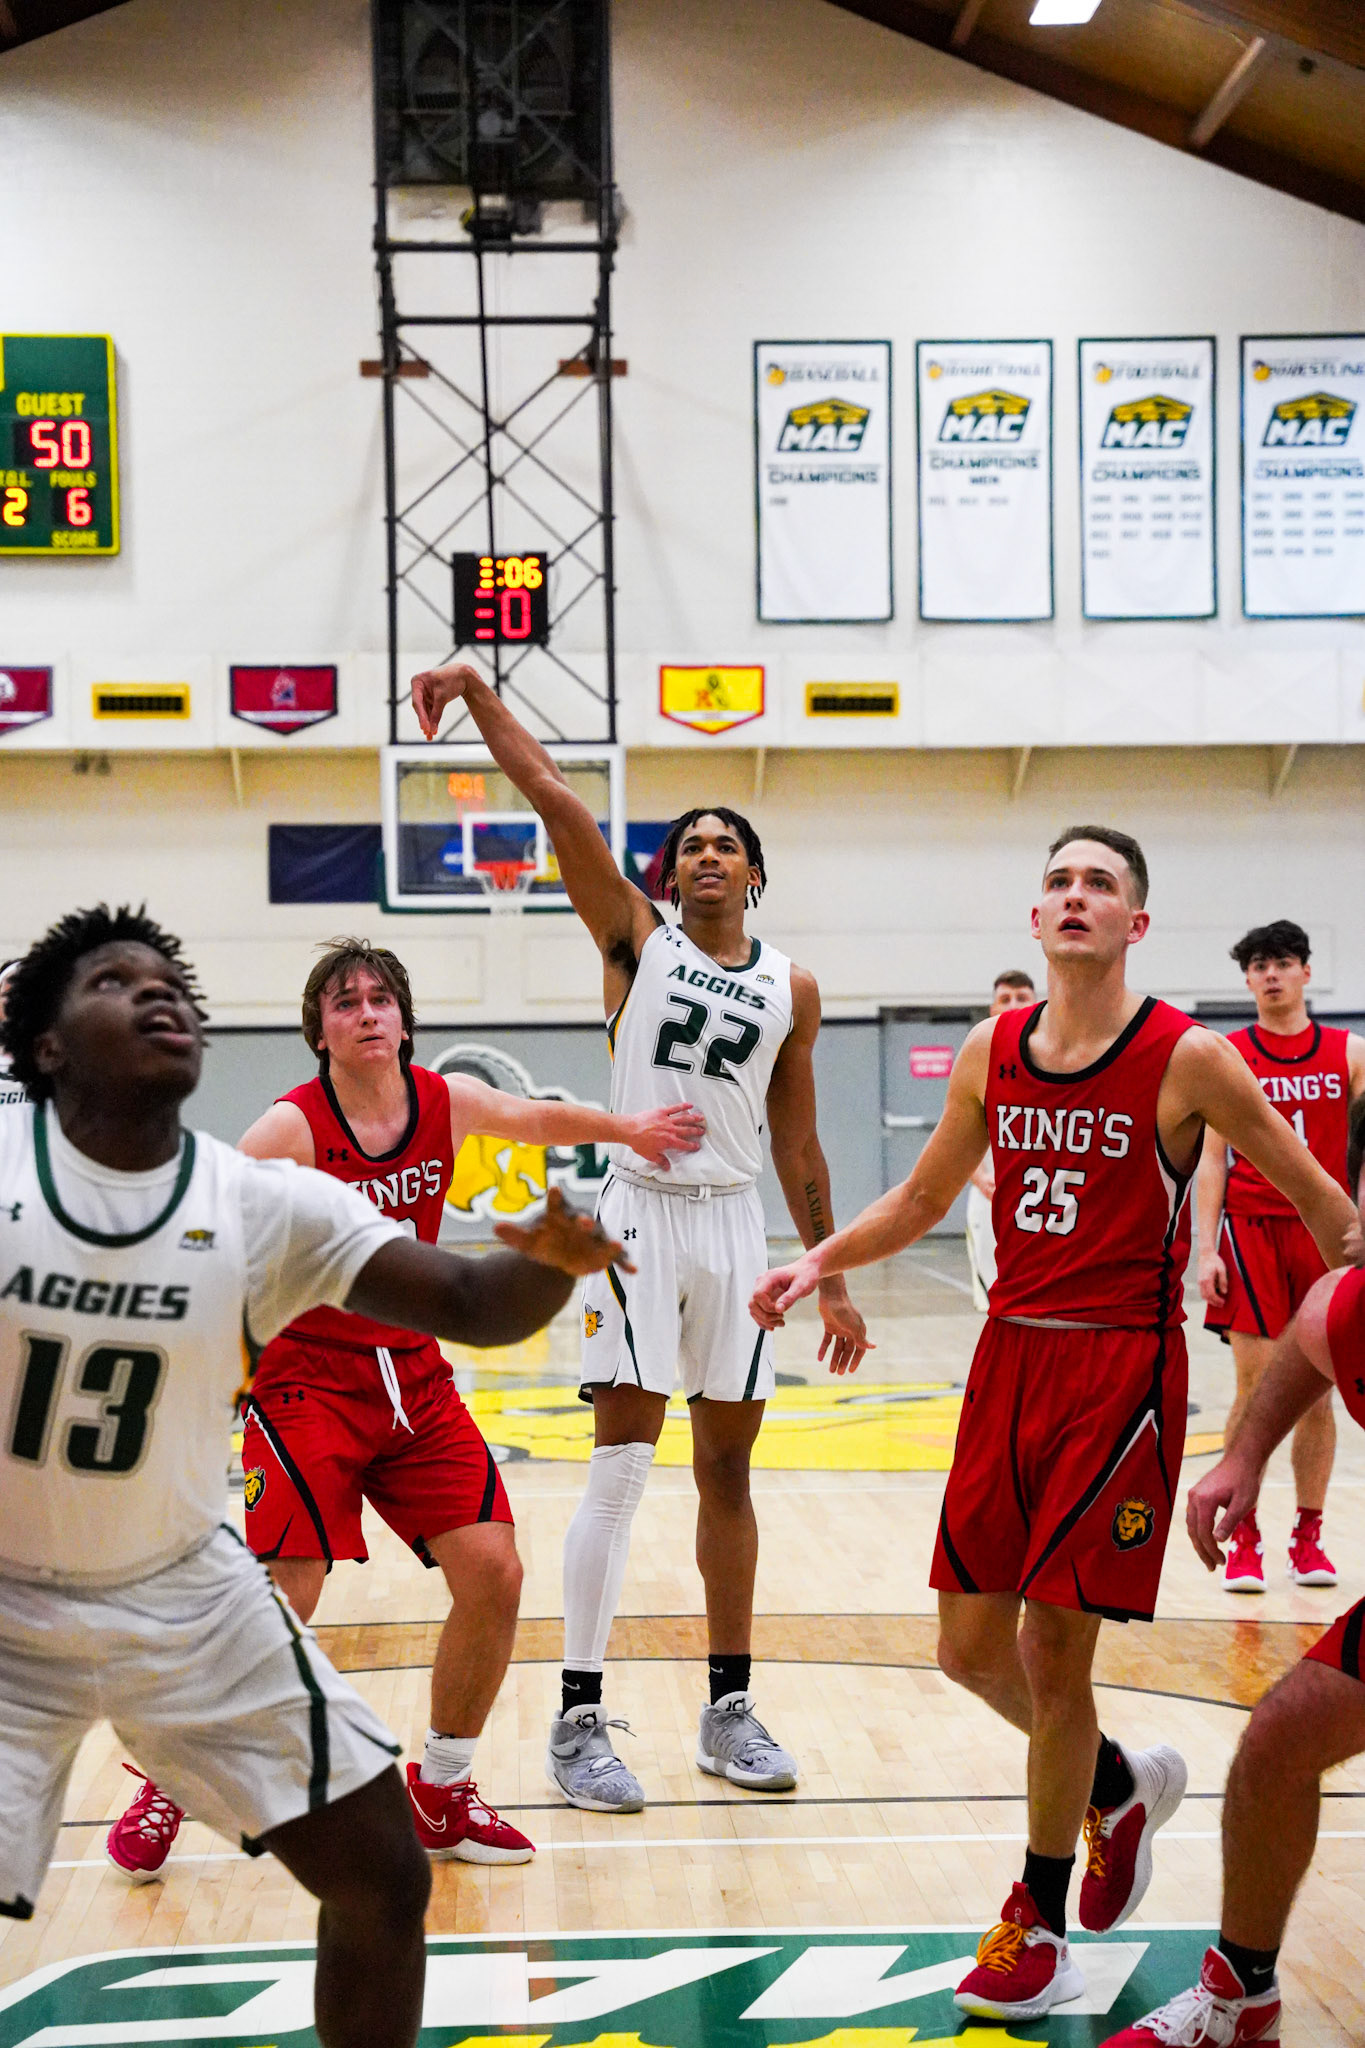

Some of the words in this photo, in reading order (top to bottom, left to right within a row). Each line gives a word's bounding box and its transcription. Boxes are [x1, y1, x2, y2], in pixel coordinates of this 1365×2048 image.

[16, 392, 84, 417] GUEST
[30, 420, 91, 469] 50
[780, 423, 866, 450] MAC
[941, 414, 1027, 440] MAC
[1104, 421, 1188, 447] MAC
[1266, 418, 1351, 445] MAC
[50, 470, 97, 488] FOULS
[3, 487, 28, 526] 2
[67, 487, 92, 526] 6
[667, 964, 766, 1010] AGGIES
[651, 991, 763, 1086] 22
[997, 1104, 1134, 1159] KING'S
[1014, 1166, 1086, 1236] 25
[1, 1265, 190, 1320] AGGIES
[6, 1328, 169, 1481] 13
